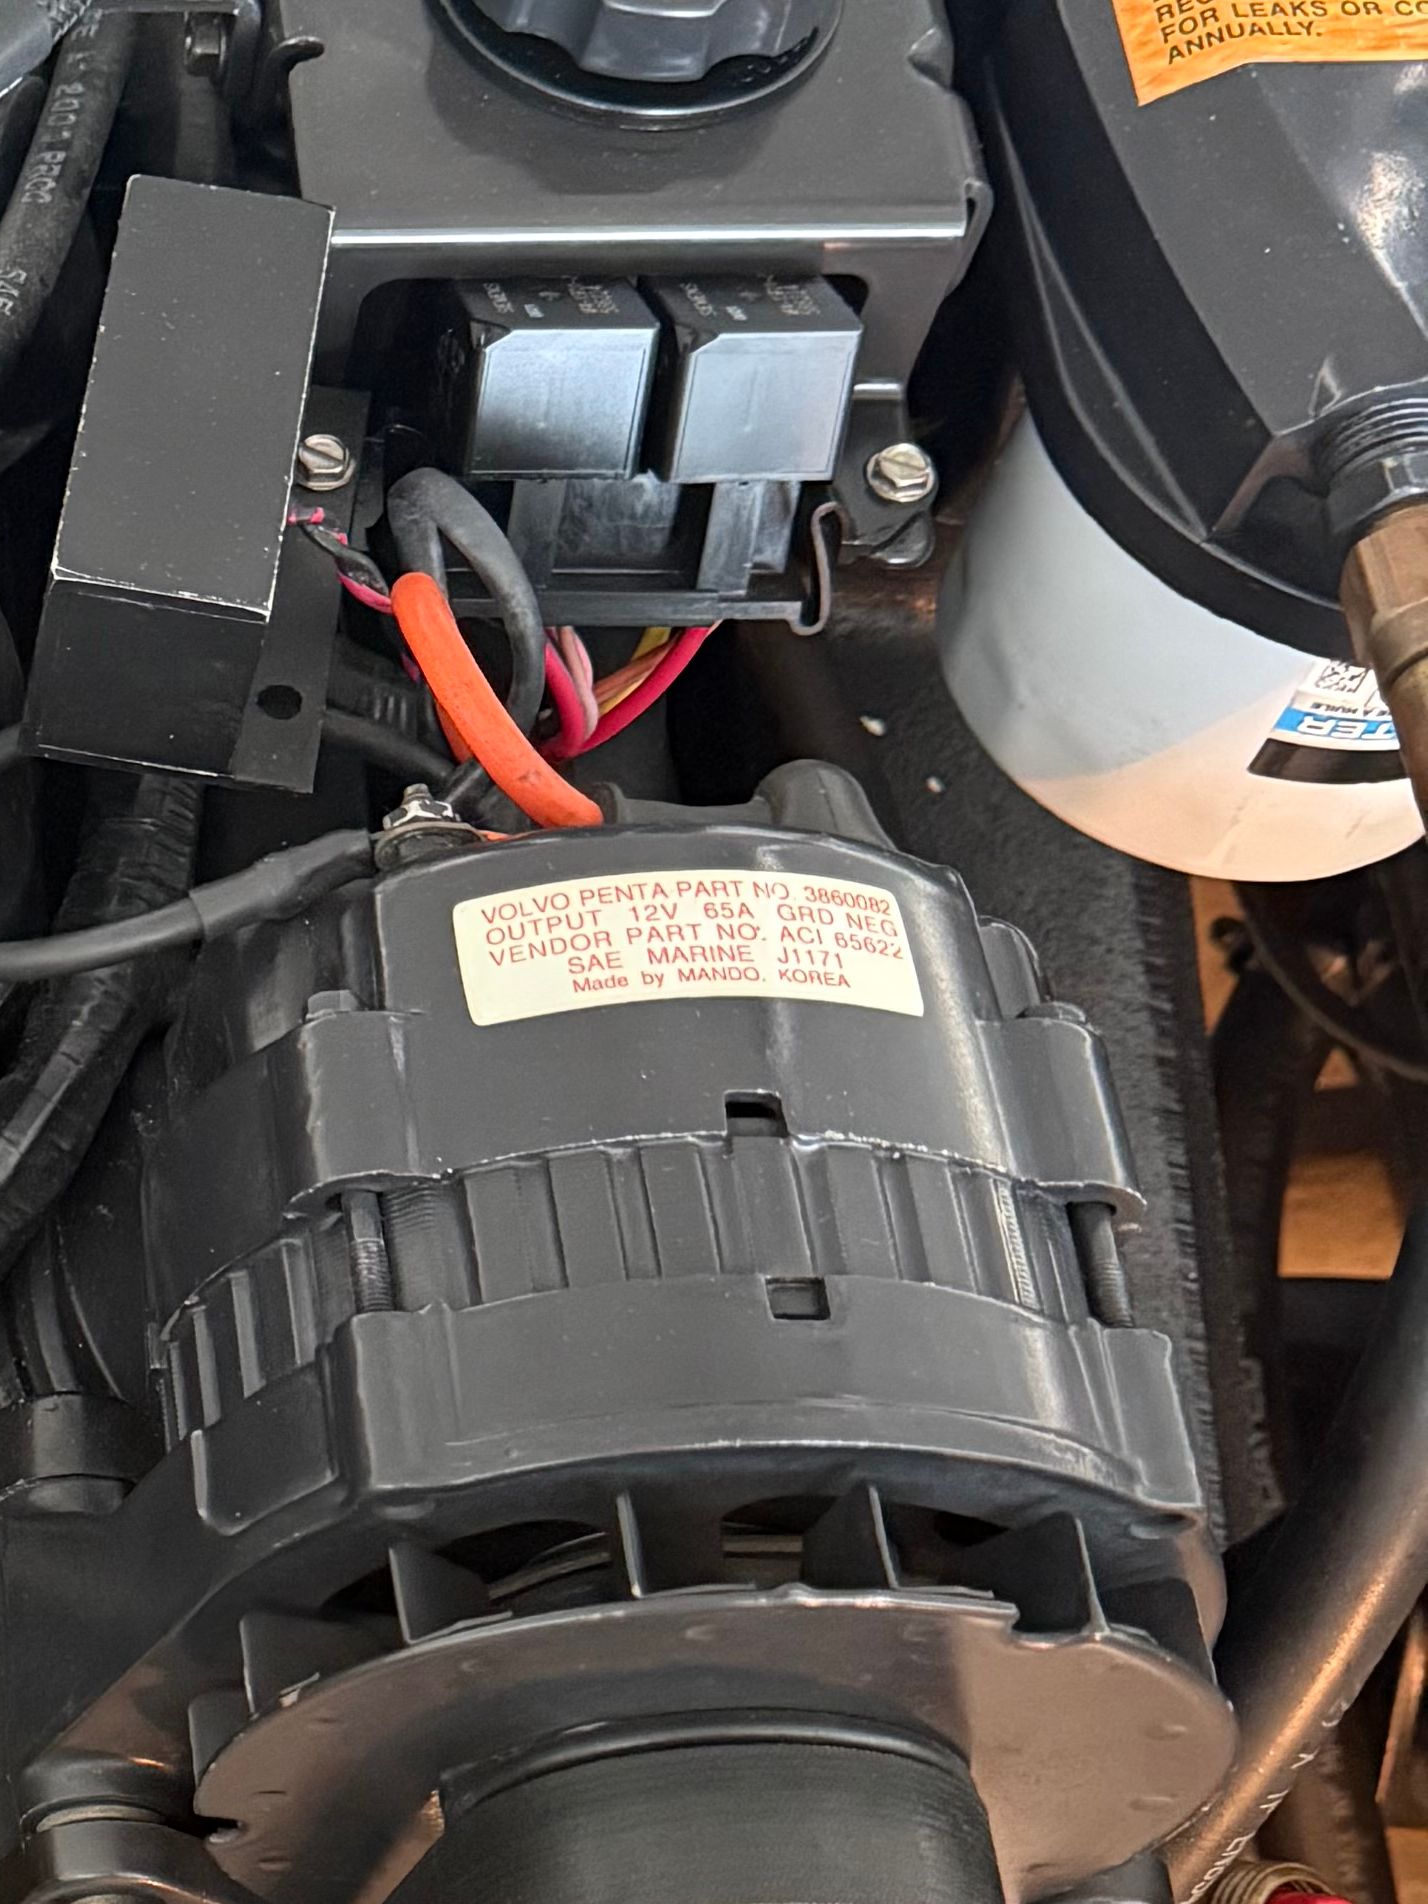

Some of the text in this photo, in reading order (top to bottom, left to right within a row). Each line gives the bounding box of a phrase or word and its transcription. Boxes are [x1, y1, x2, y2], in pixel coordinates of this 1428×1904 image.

[1159, 7, 1220, 44] FOR
[1231, 0, 1328, 19] LEAKS
[1340, 0, 1383, 16] OR
[1167, 19, 1324, 65] ANNUALLY.
[481, 892, 570, 924] VOLVO
[579, 882, 669, 906] PENTA
[676, 880, 744, 899] PART
[803, 885, 892, 916] 3860082
[486, 902, 899, 945] OUTPUT 12V 65A GRD NEG
[489, 929, 612, 967] VENDOR
[626, 923, 702, 945] PART
[779, 925, 824, 945] ACI
[834, 932, 904, 960] 65622
[567, 944, 844, 975] SAE MARINE J1171
[572, 974, 629, 993] Made
[640, 970, 665, 988] by
[778, 968, 852, 988] KOREA
